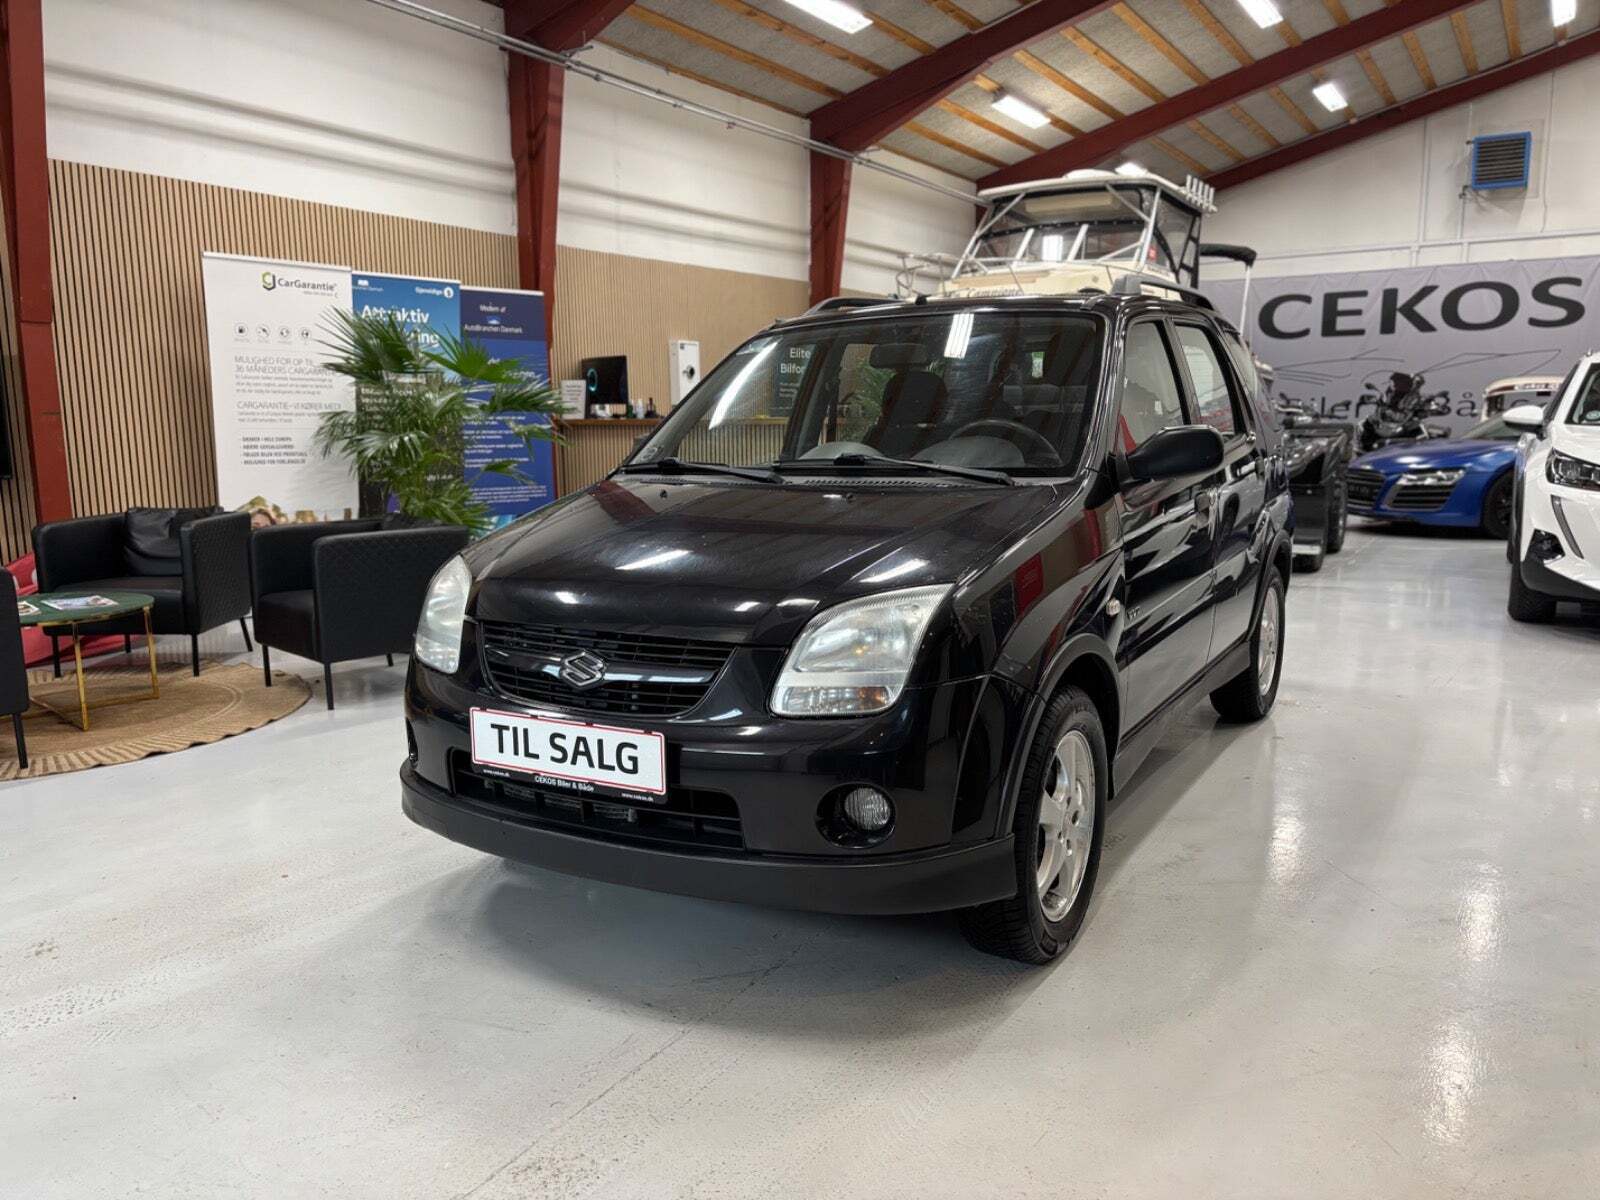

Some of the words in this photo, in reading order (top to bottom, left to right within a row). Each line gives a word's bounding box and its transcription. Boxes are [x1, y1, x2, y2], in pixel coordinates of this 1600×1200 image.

[278, 278, 335, 291] CarGarantie
[1258, 276, 1586, 340] CEKOS
[790, 347, 812, 359] Elite
[490, 723, 540, 760] TIL
[549, 732, 639, 775] SALG
[534, 775, 557, 786] CEKOS
[557, 779, 571, 788] Biler
